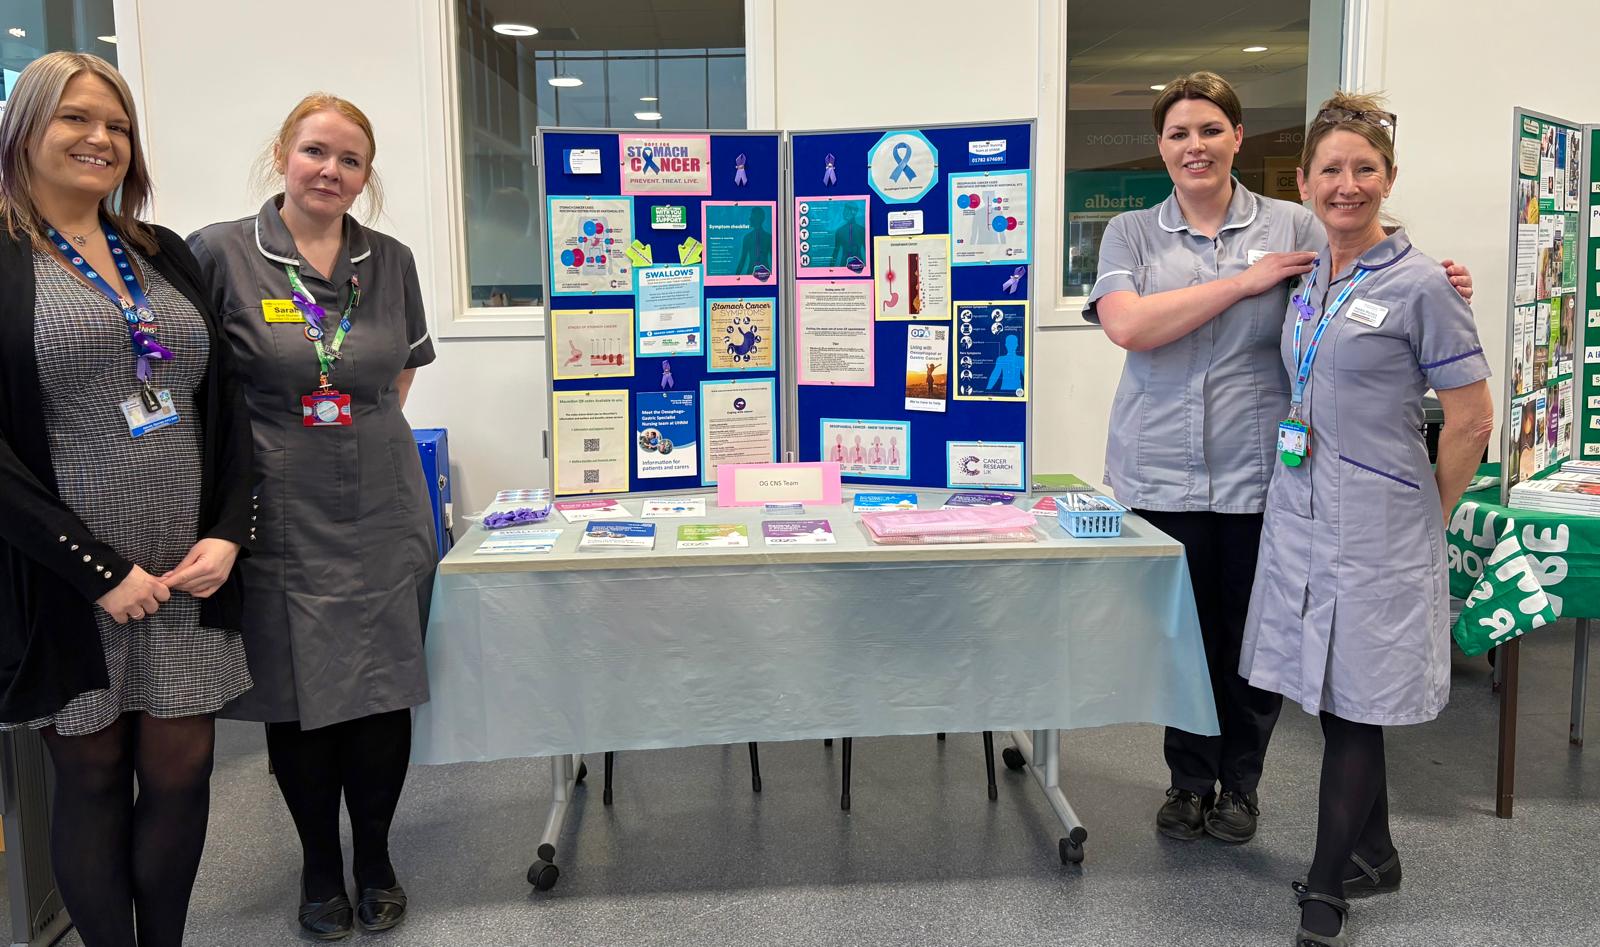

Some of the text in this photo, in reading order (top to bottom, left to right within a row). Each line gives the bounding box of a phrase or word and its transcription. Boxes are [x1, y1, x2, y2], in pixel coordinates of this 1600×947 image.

[1086, 134, 1154, 145] SMOOTHIES
[627, 146, 689, 158] STOMACH
[630, 157, 701, 173] CANCER
[1277, 176, 1296, 187] ICE
[1085, 194, 1144, 208] alberts
[645, 269, 694, 279] SWALLOWS
[712, 302, 744, 311] Stomach
[911, 329, 930, 337] OPA
